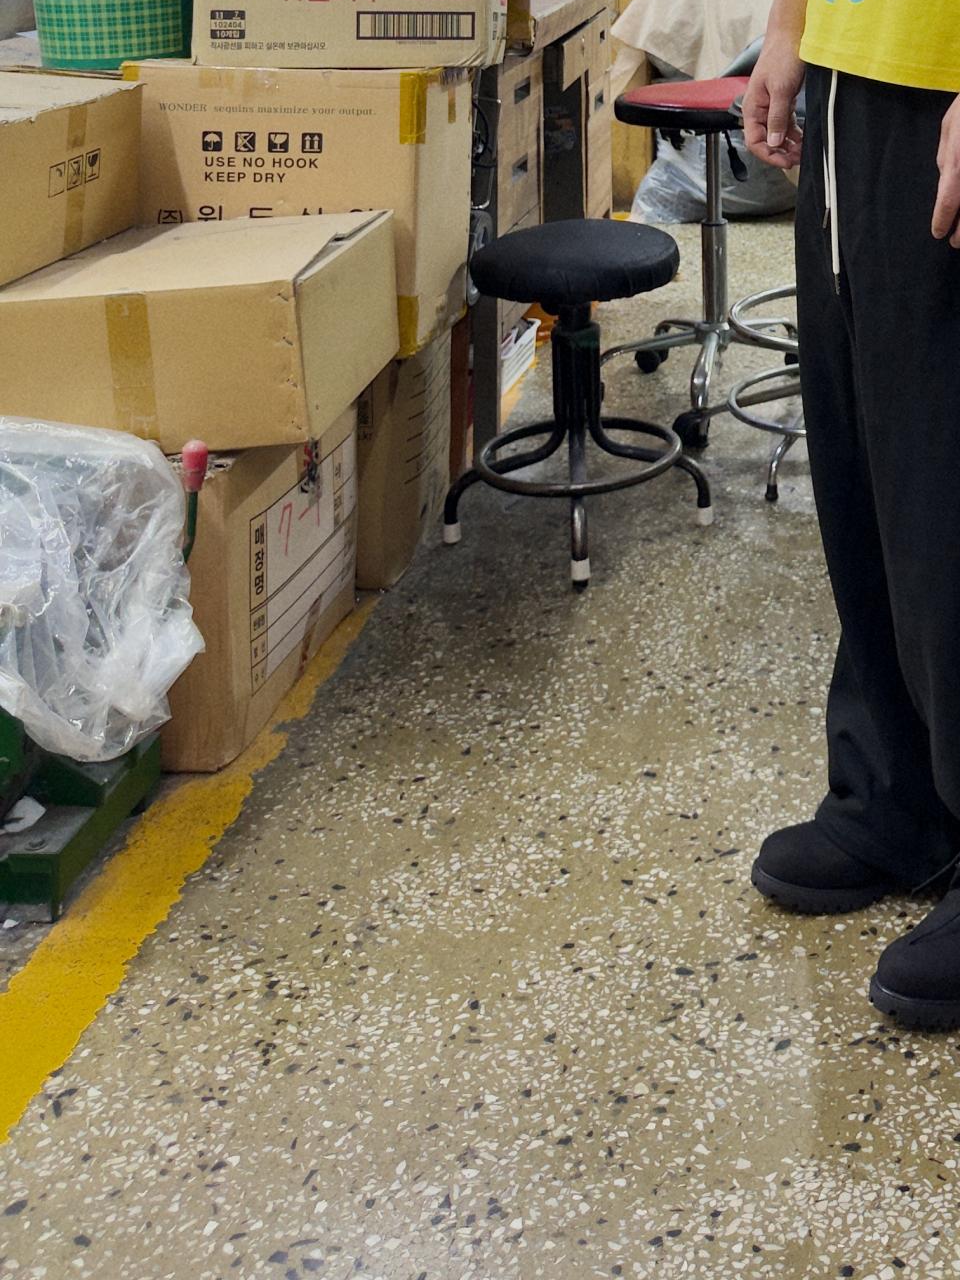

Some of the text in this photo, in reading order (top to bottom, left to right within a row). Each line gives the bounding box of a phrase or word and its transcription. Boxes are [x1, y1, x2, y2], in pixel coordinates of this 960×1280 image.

[158, 102, 208, 113] WONDER
[213, 104, 254, 114] sequins
[257, 104, 309, 114] maximize
[312, 106, 336, 116] your
[204, 156, 319, 169] USE NO HOOK
[204, 171, 286, 183] KEEP DRY
